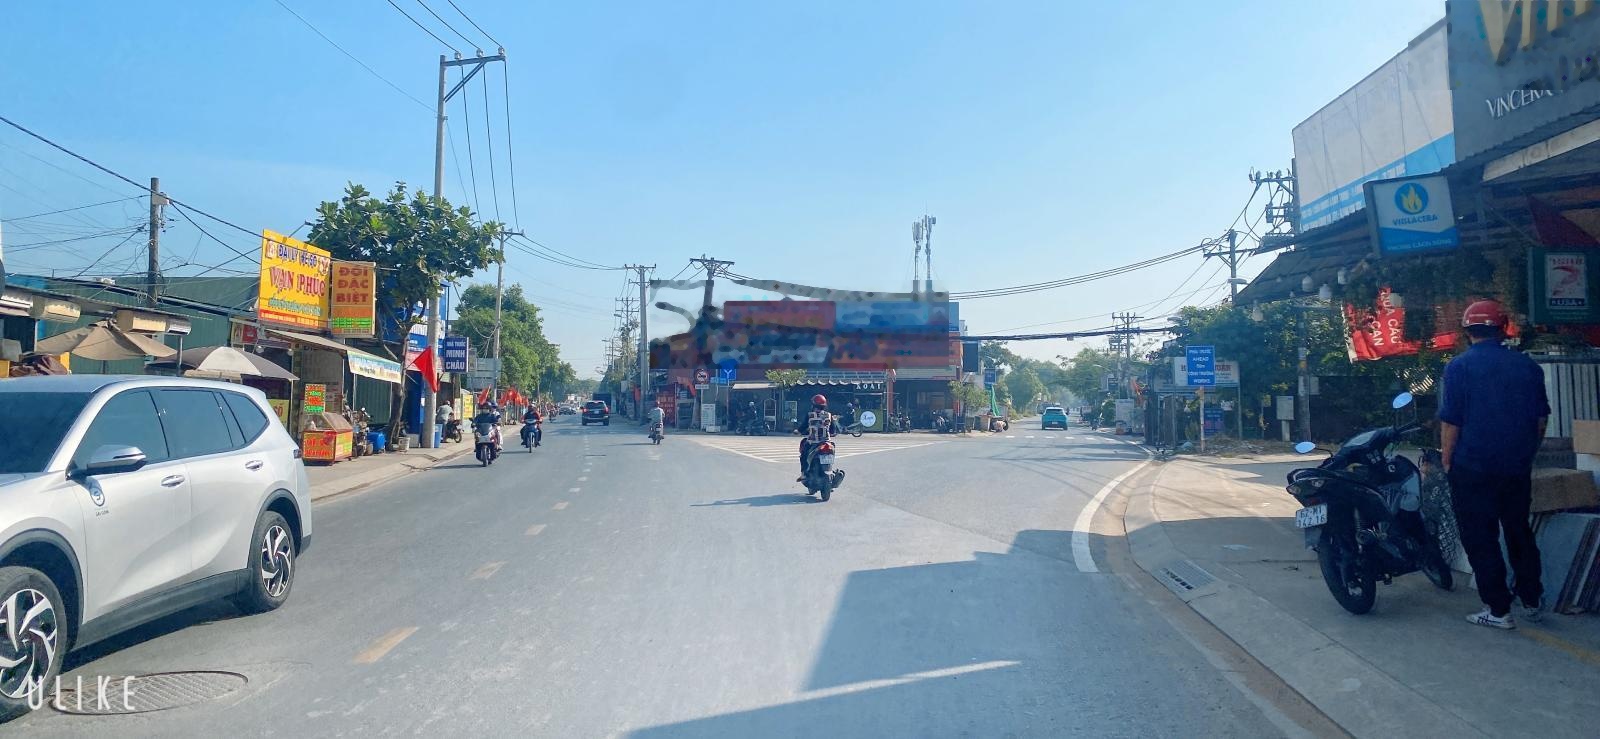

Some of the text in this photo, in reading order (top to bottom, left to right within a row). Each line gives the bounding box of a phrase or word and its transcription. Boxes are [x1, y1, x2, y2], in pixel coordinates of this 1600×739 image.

[270, 266, 326, 297] VẠN PHÚC
[336, 291, 369, 304] BIỆT
[446, 350, 466, 358] MINH
[446, 360, 465, 370] CHÂU
